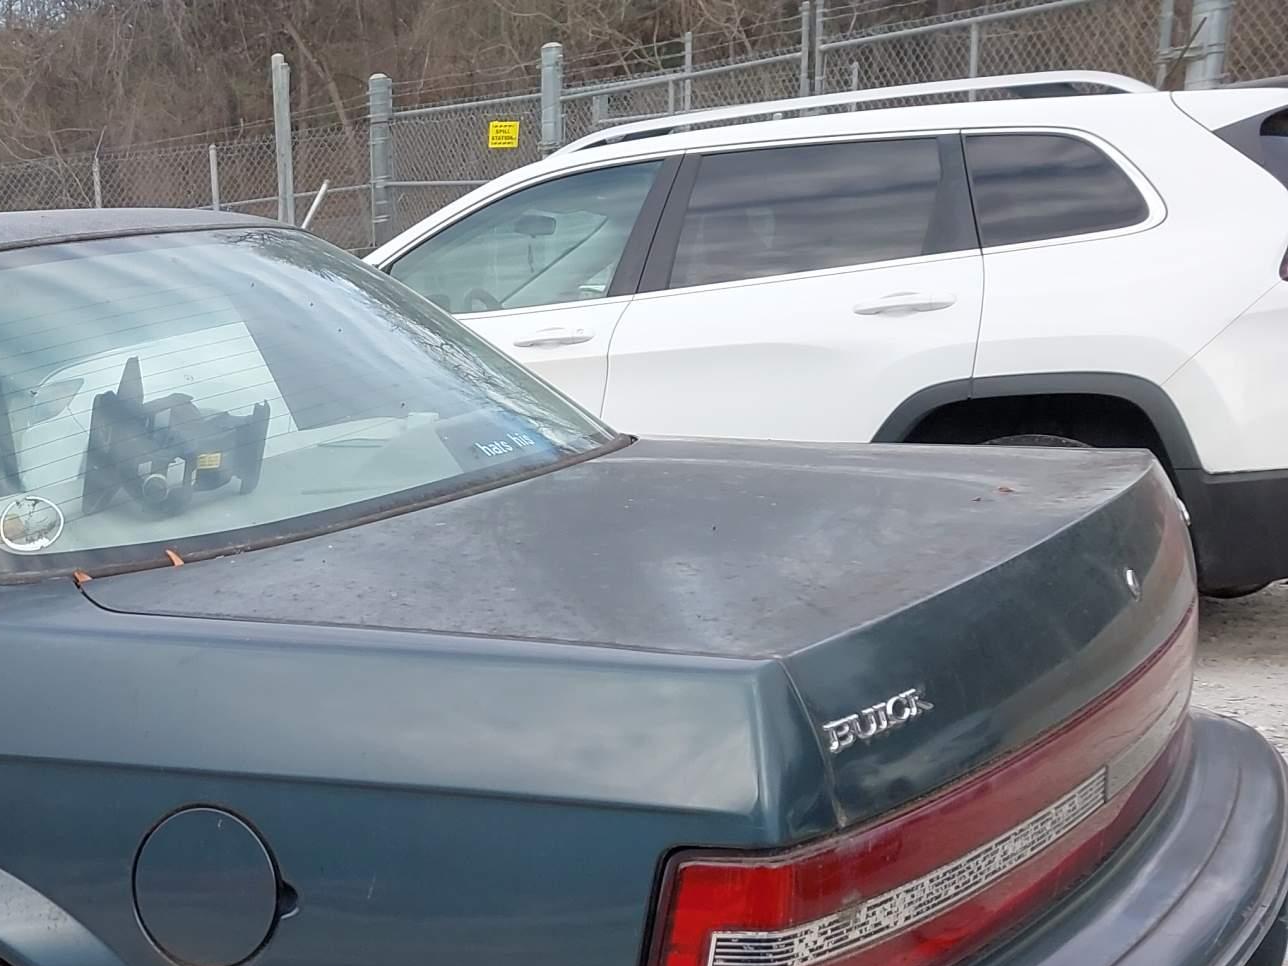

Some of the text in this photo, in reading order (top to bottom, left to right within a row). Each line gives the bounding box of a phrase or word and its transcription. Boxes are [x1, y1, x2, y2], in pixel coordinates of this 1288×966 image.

[474, 432, 536, 457] hats his
[822, 688, 935, 754] BUICK
